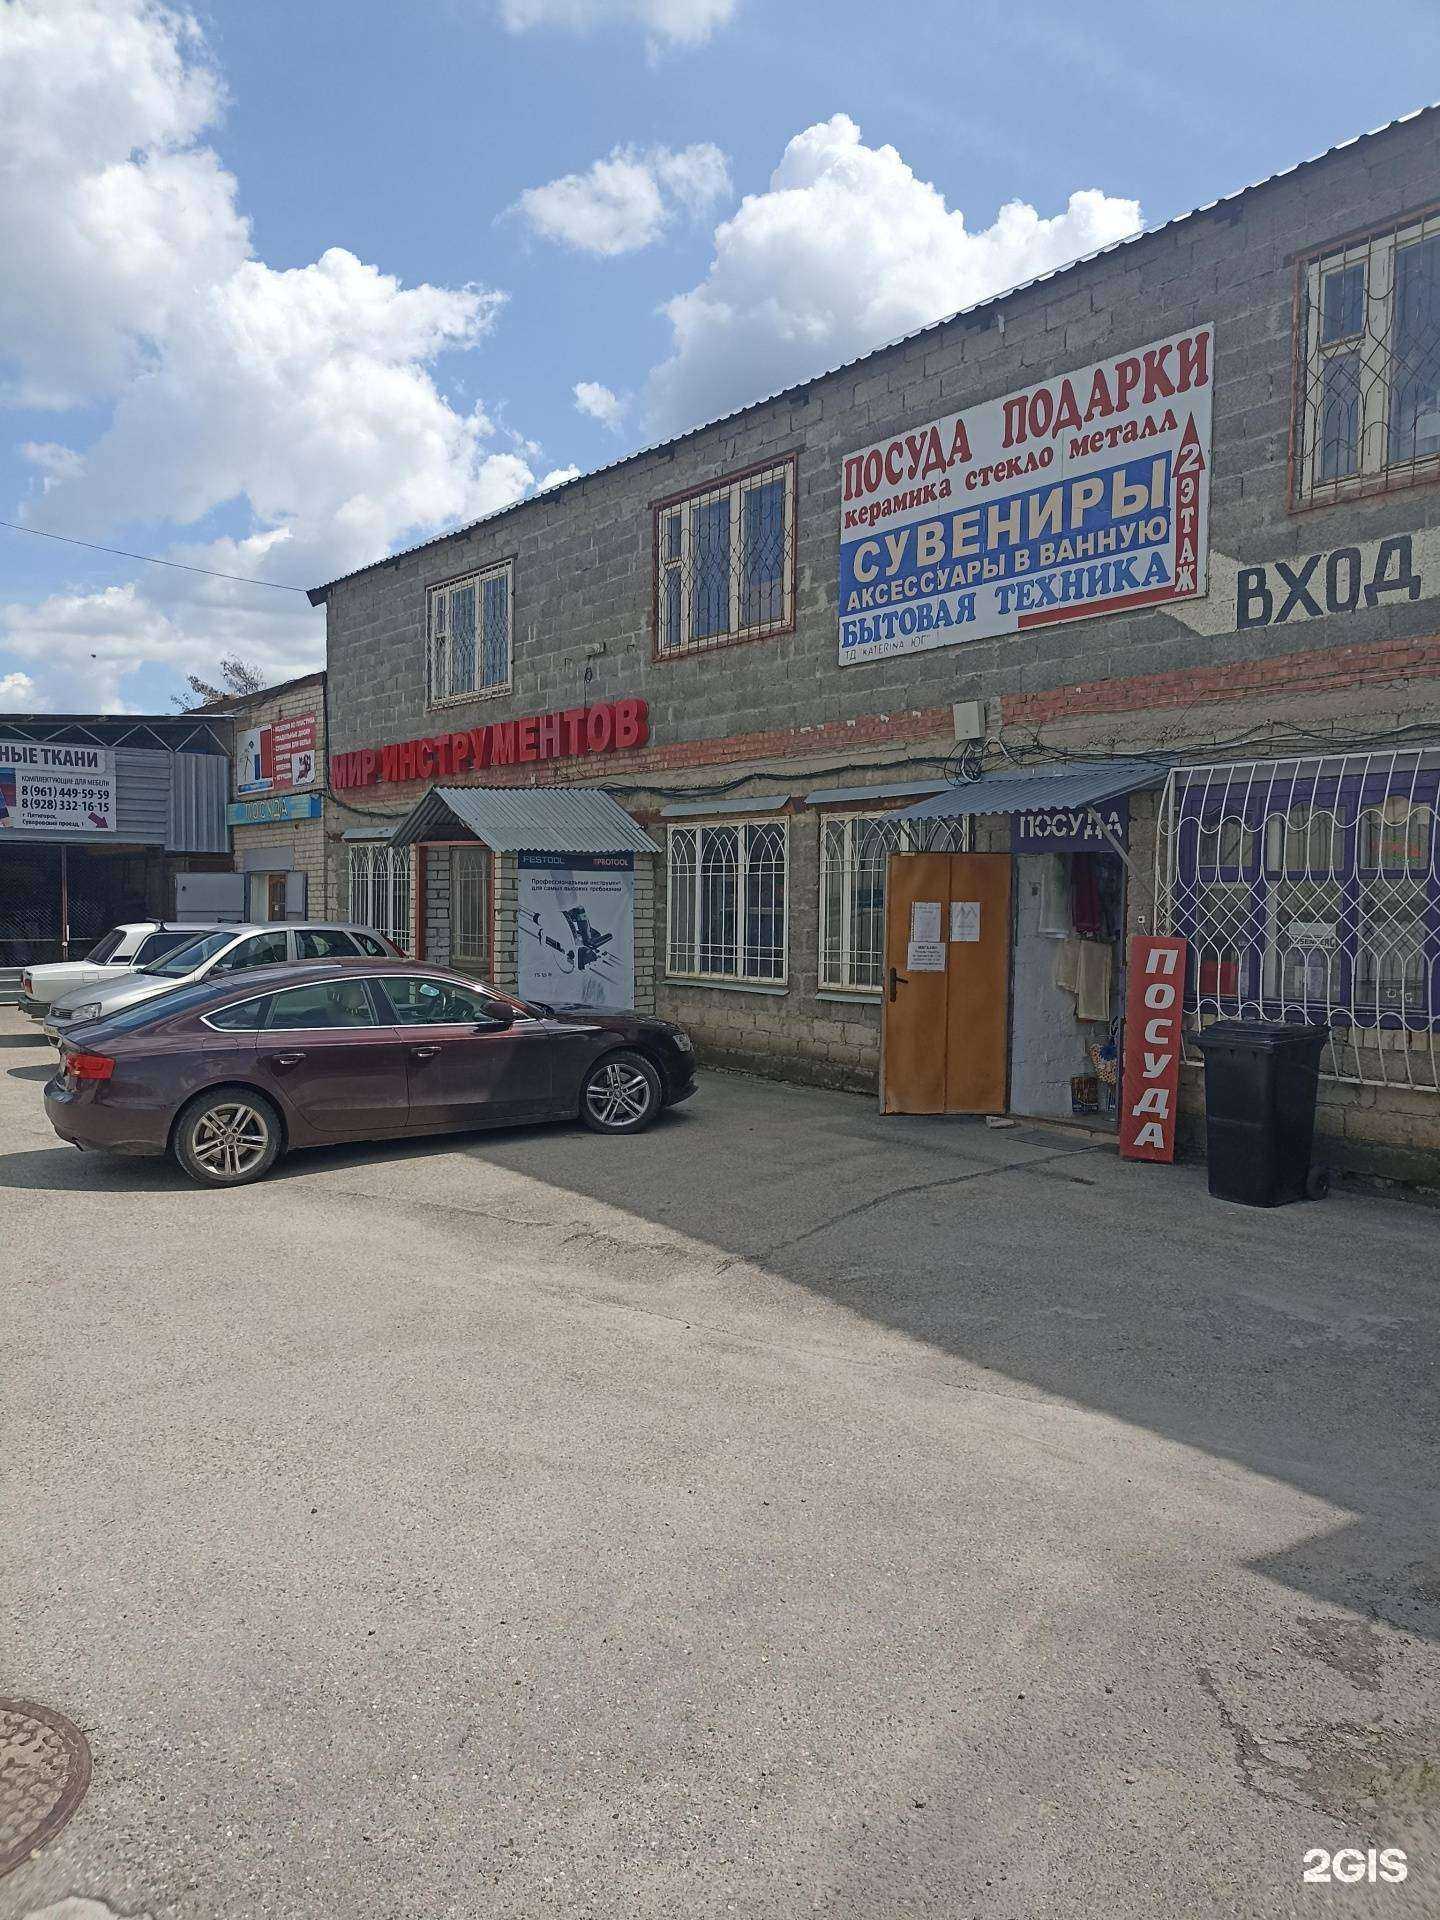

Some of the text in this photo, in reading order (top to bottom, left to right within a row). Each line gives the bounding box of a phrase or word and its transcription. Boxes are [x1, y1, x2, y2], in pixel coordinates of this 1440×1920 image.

[843, 331, 1210, 501] ПОСУДА ПОДАРКИ
[844, 409, 1178, 530] керамика стекло металл
[847, 516, 1167, 612] АКСЕССУАРЫ В ВАННУЮ
[853, 458, 1167, 583] СУВЕНИРЫ
[1174, 443, 1199, 592] 2 ЭТАЖ
[841, 551, 1171, 649] БЫТОВАЯ ТЕХНИКА
[1236, 535, 1422, 630] ВХОД
[41, 748, 98, 768] ТКАНИ
[331, 698, 648, 790] МИР ИНСТРУМЕНТОВ
[59, 787, 110, 800] 449-59-59
[59, 800, 110, 812] 332-16-15
[1019, 810, 1123, 840] ПОСУДА
[523, 855, 565, 865] FESTOOL
[1132, 948, 1180, 1149] ПОСУДА
